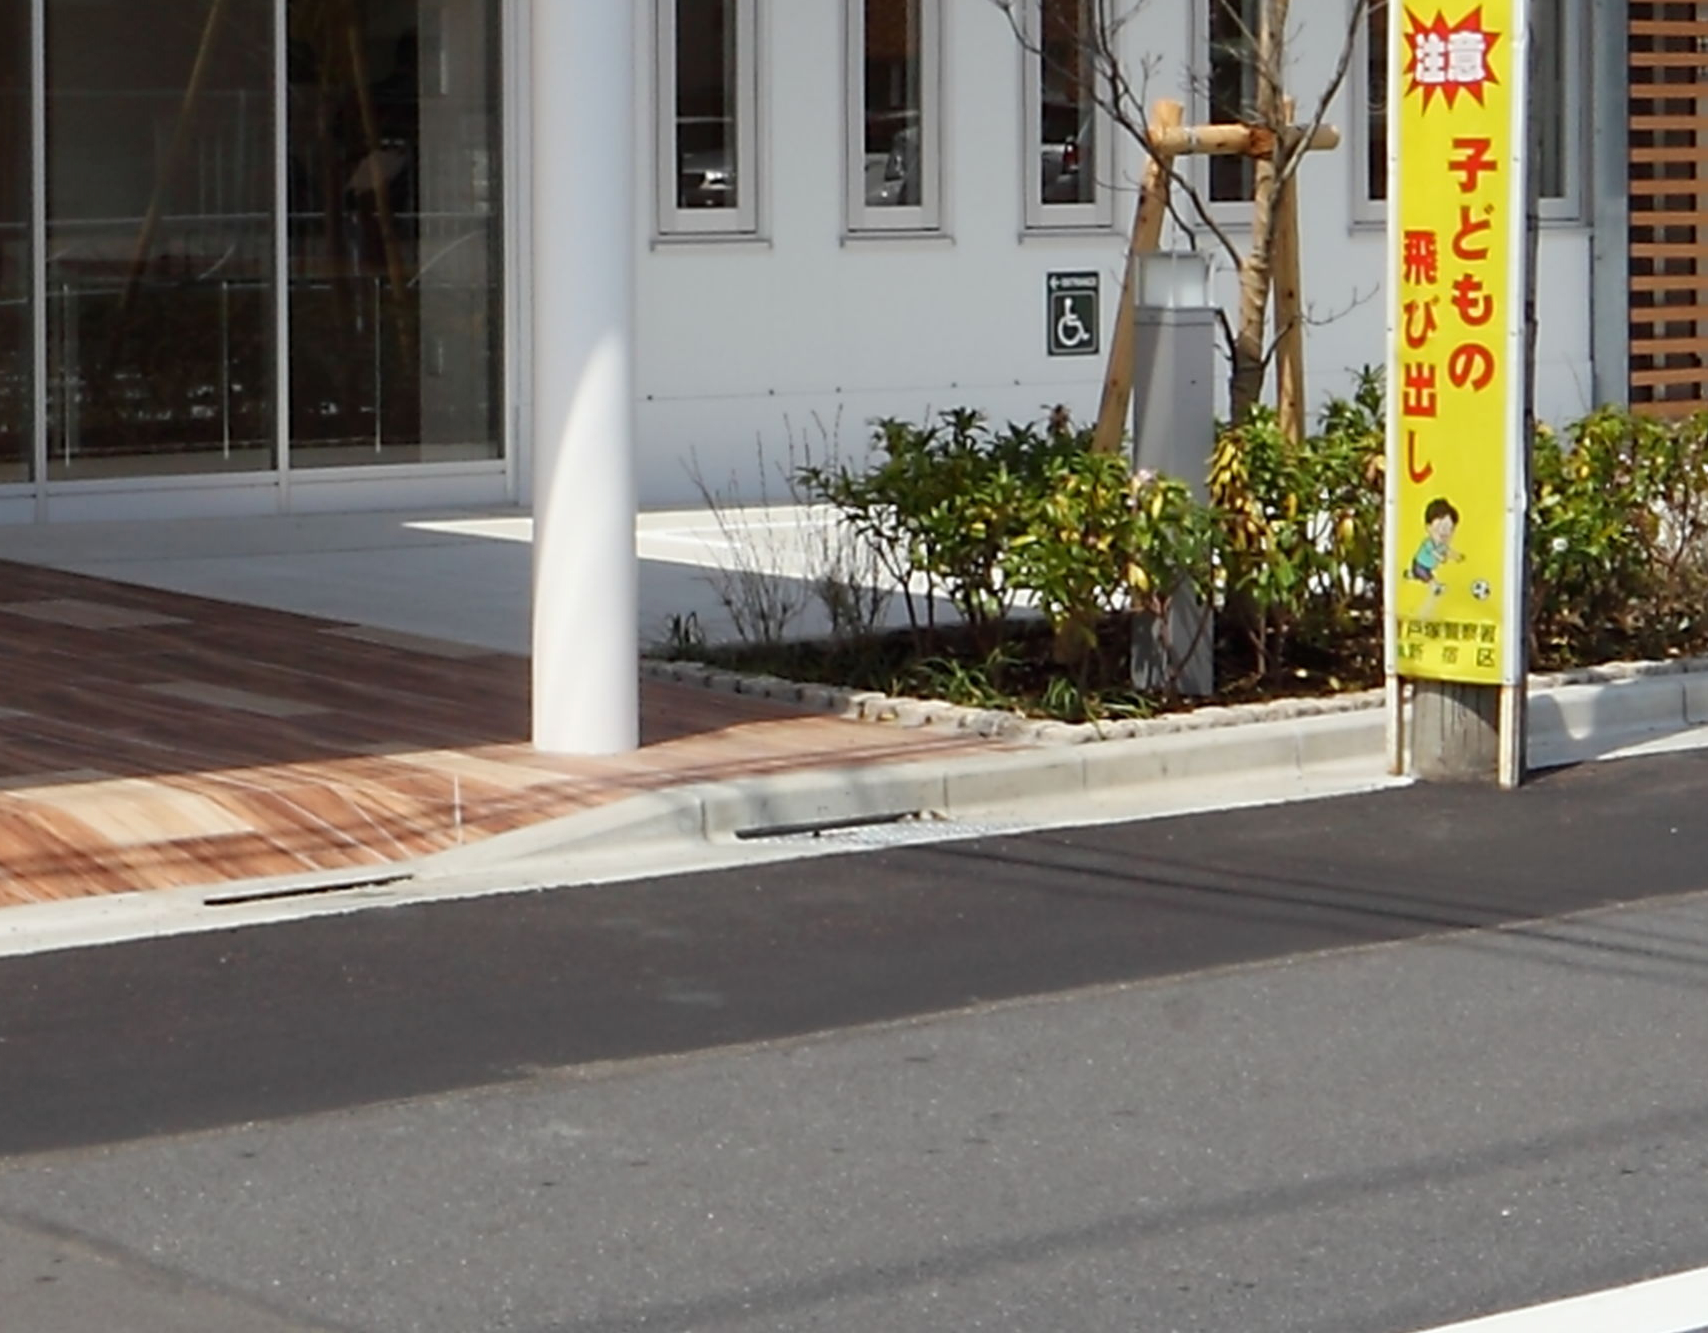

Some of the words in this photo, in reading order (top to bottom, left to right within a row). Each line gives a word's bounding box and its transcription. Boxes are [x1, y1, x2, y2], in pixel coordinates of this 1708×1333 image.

[1414, 31, 1486, 83] 注意
[1402, 229, 1440, 485] 飛び出し
[1447, 138, 1498, 393] 子どもの
